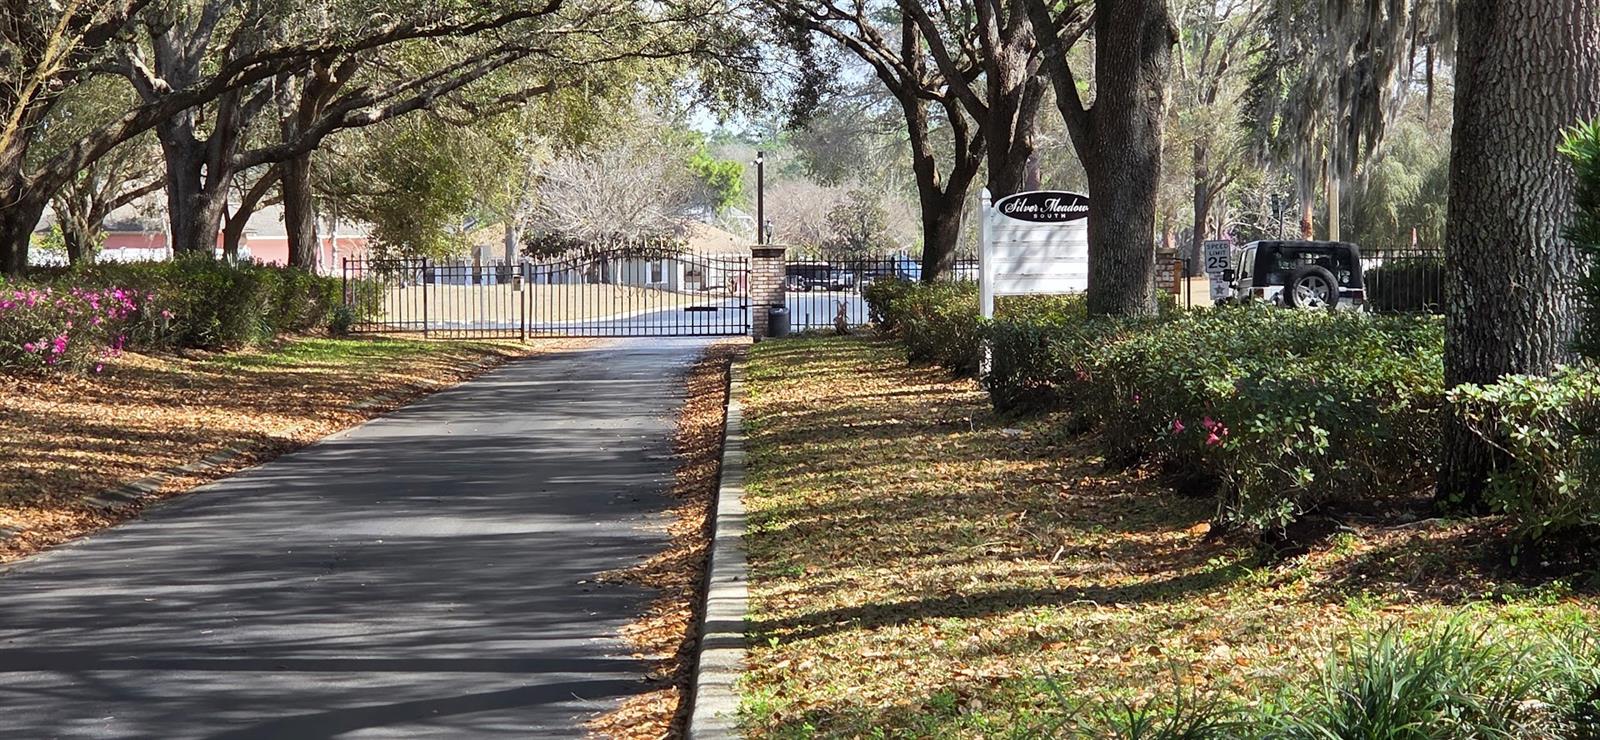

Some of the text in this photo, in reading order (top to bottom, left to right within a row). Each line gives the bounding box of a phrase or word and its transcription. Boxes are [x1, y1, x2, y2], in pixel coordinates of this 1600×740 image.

[1004, 198, 1089, 213] Silver Meadow
[1208, 256, 1228, 268] 25
